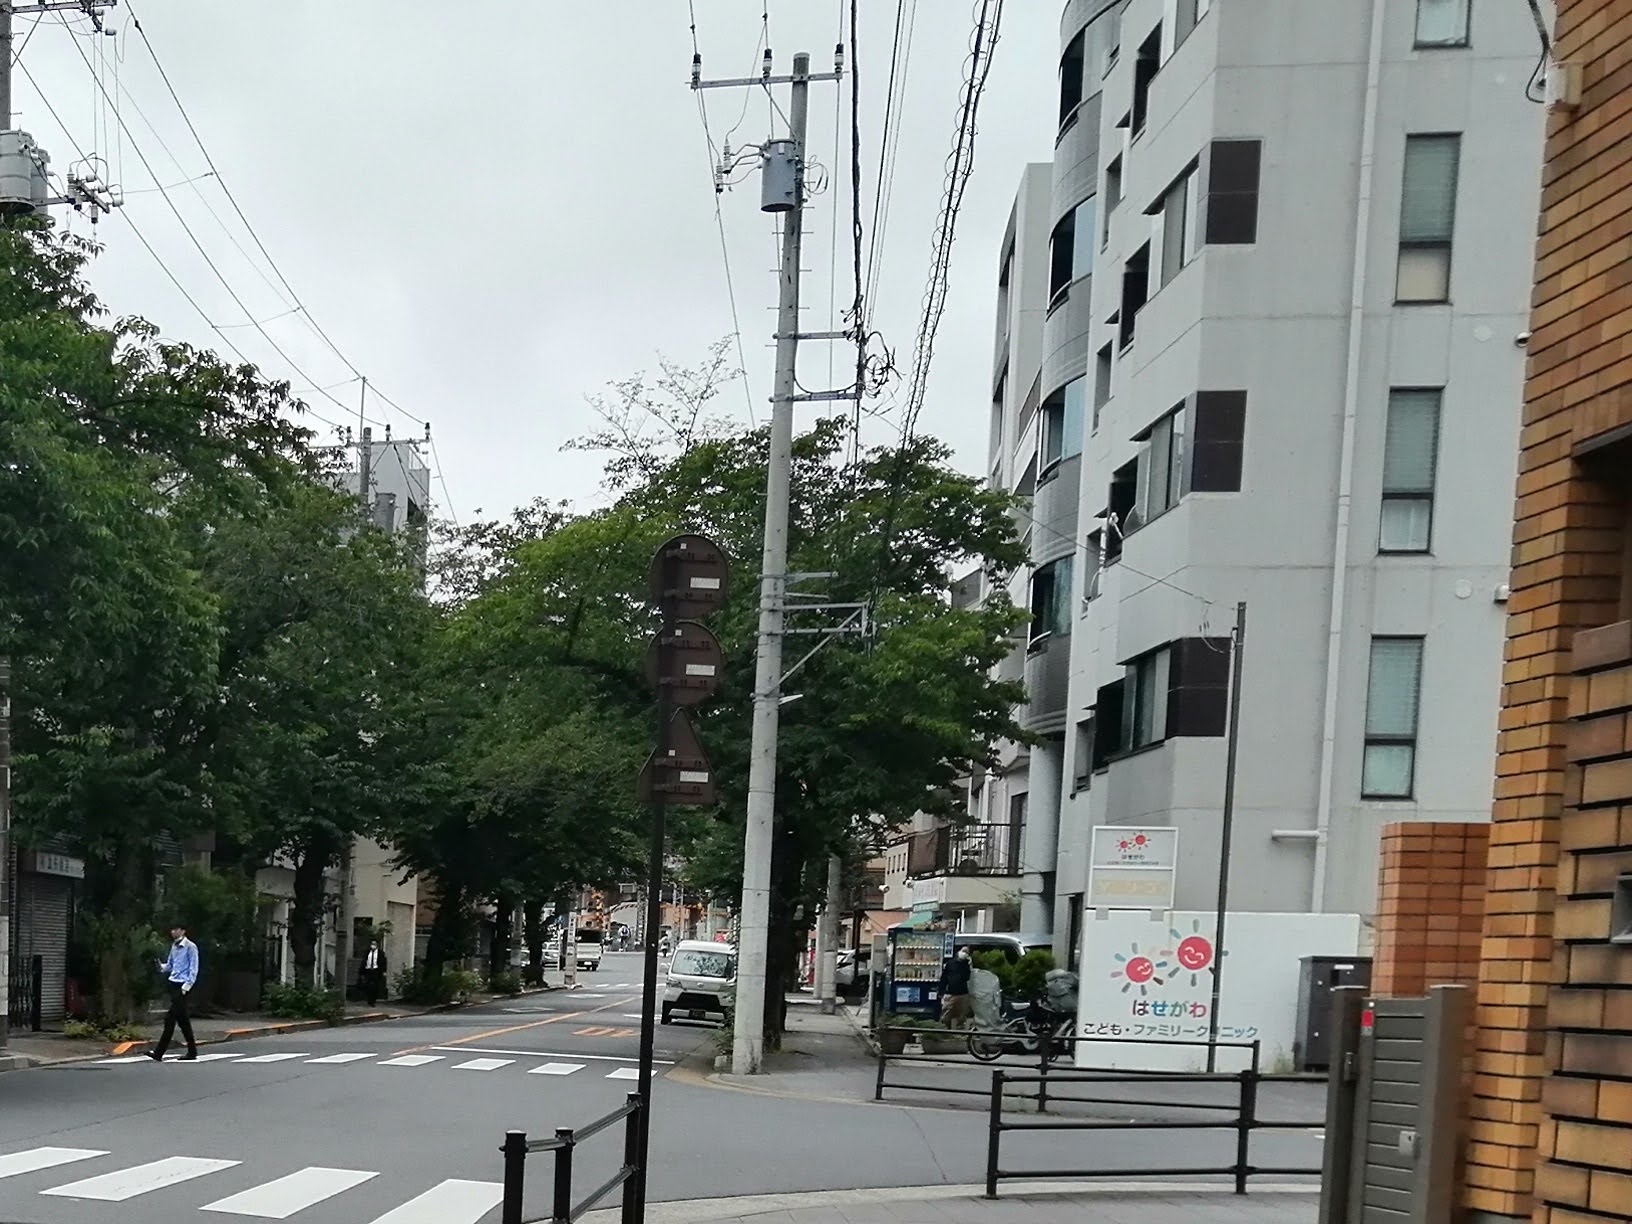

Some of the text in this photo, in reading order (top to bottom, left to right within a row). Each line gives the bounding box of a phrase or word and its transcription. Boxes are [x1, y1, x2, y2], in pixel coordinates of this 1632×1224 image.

[1132, 1000, 1207, 1018] はせがわ
[1084, 1022, 1259, 1038] こども・ファミリークニック
